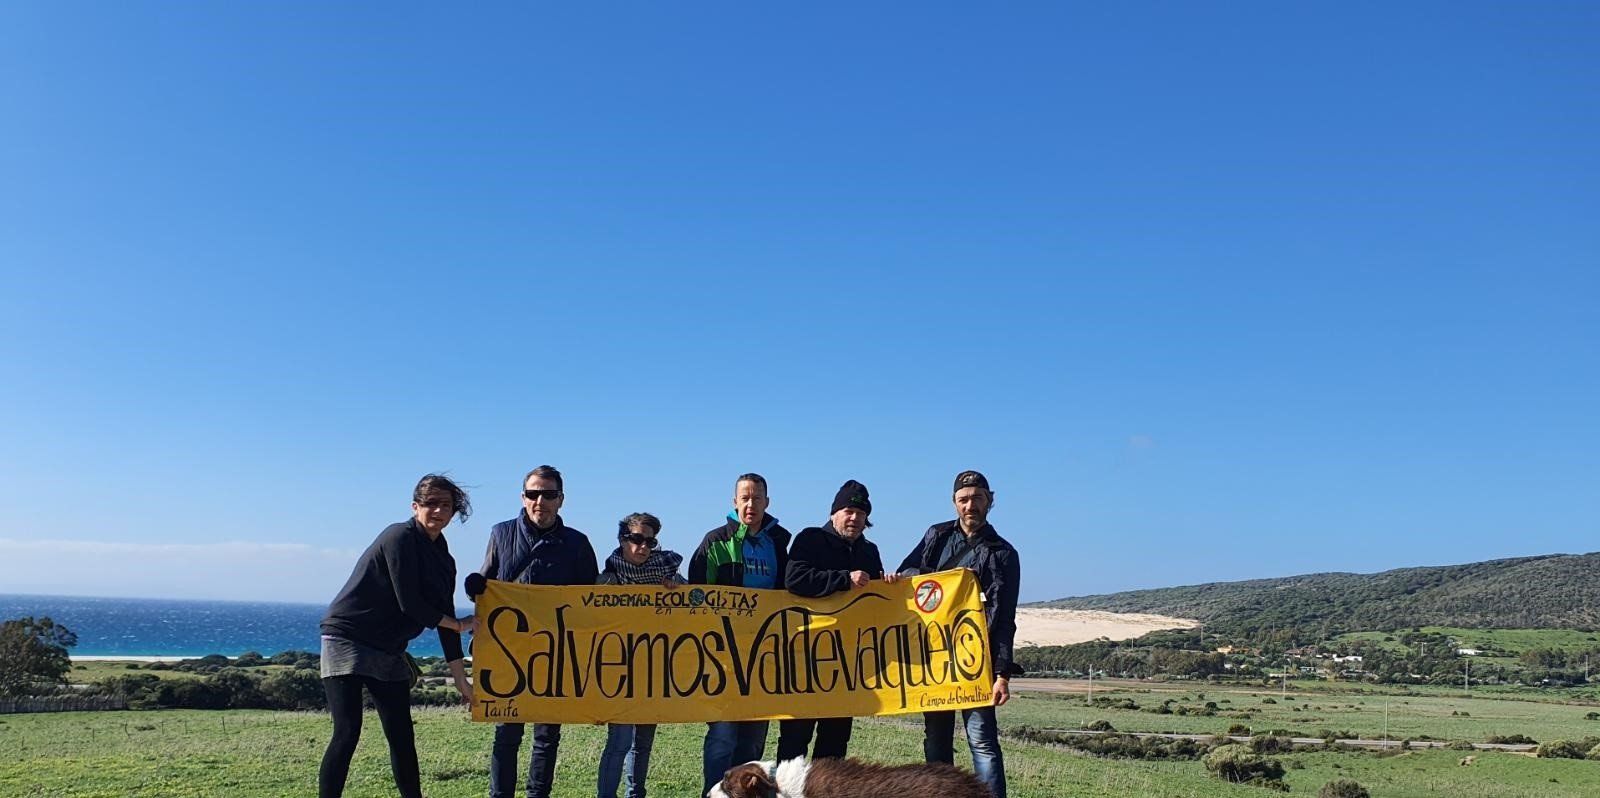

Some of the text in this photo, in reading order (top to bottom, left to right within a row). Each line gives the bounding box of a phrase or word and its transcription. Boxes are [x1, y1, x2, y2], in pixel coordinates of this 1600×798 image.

[581, 588, 759, 609] VERDEMAR ECOLOGISTAS
[480, 604, 727, 698] Salvemos
[480, 699, 519, 718] Tarifa
[920, 692, 946, 708] Campo
[947, 691, 956, 704] de
